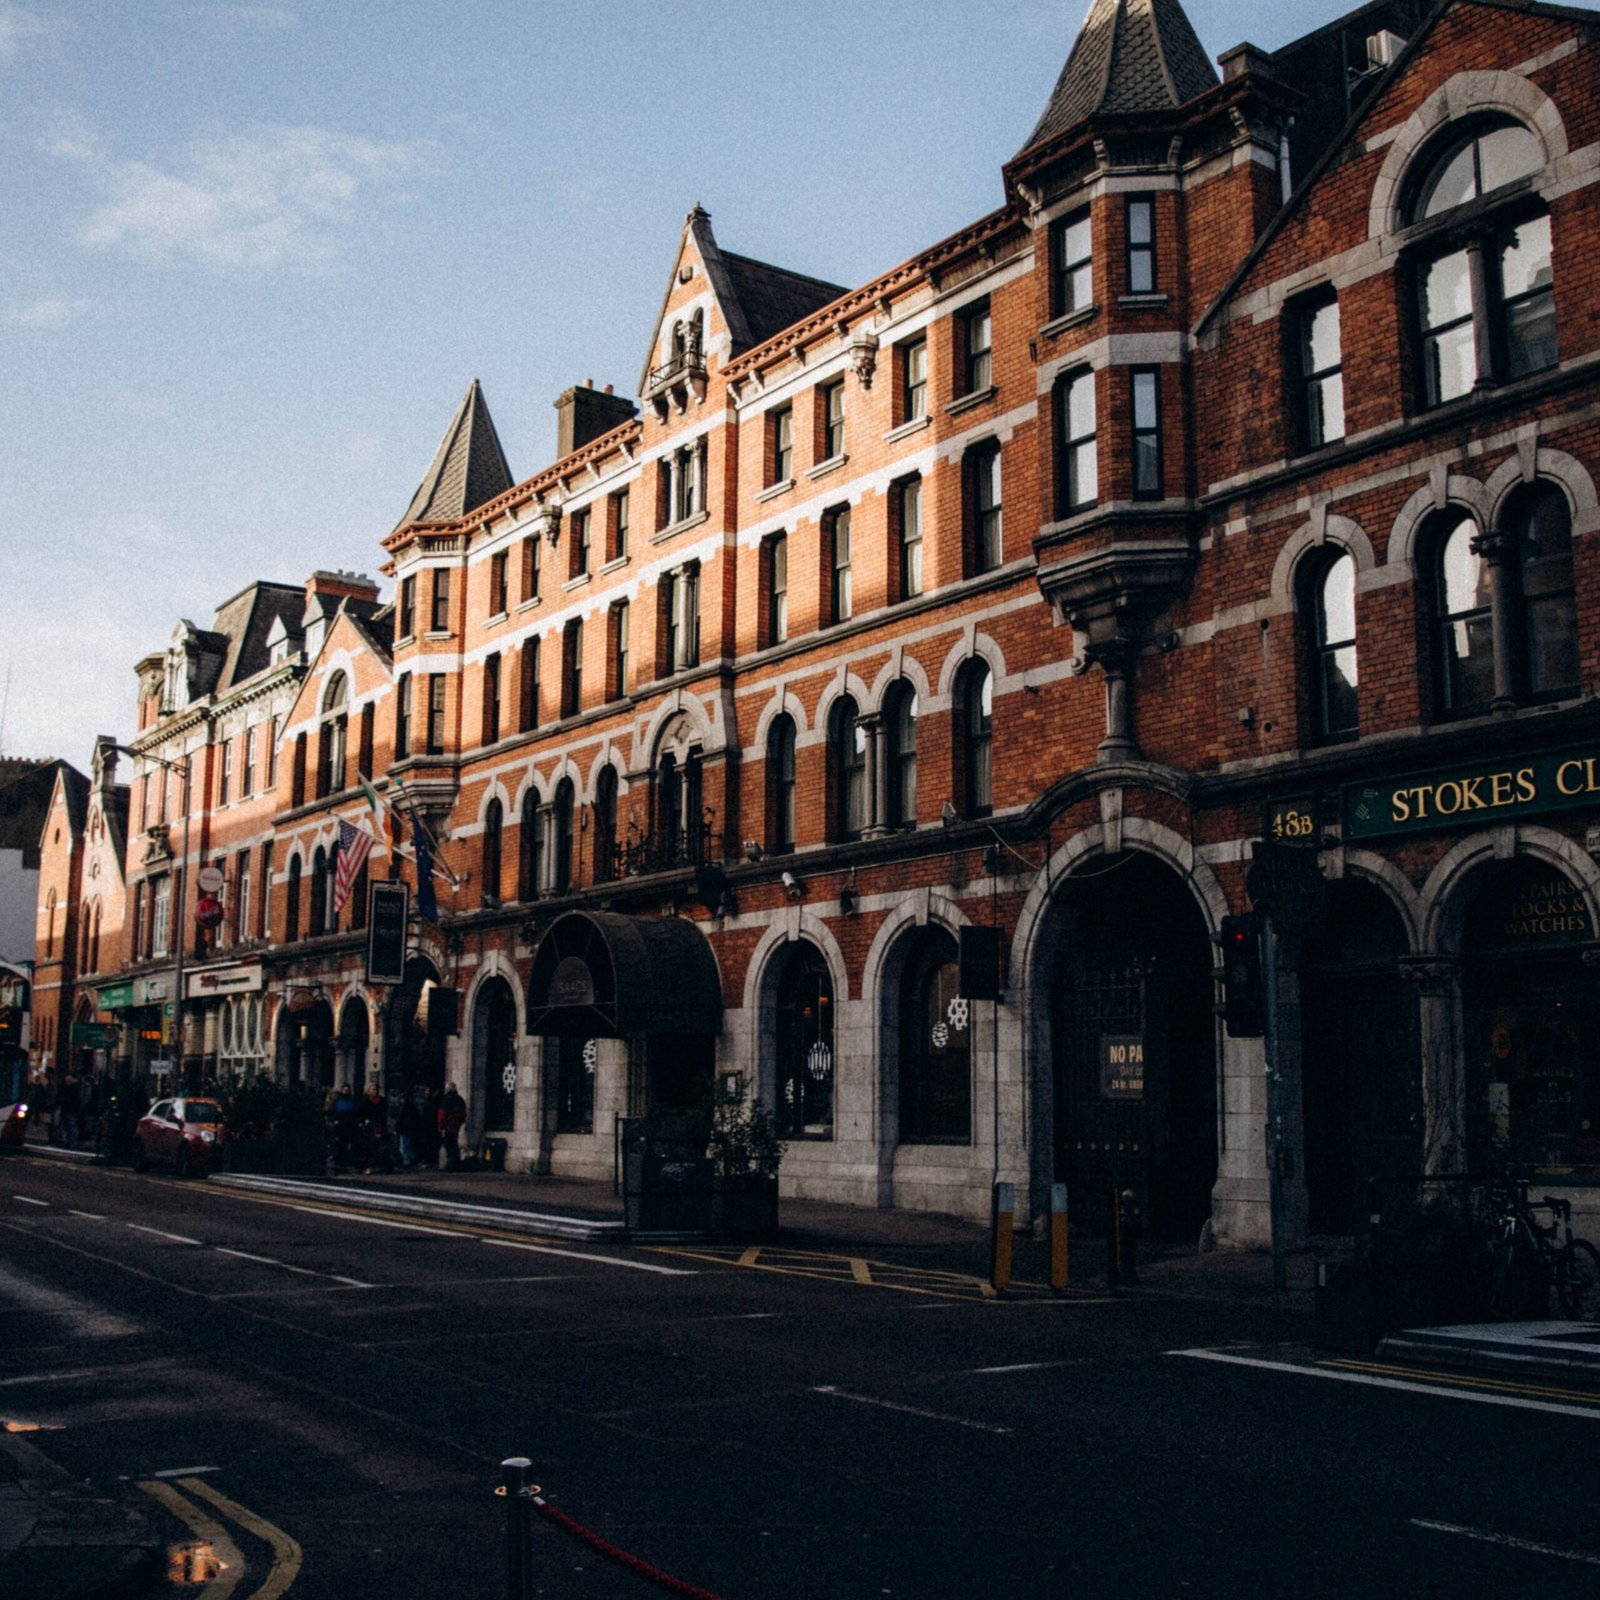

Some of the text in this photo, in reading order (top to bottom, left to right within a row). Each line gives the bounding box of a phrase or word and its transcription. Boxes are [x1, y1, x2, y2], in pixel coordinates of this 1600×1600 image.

[1391, 768, 1536, 822] STOKES
[1572, 896, 1585, 912] &
[1503, 914, 1586, 936] WATCHES
[1109, 1044, 1126, 1063] NO
